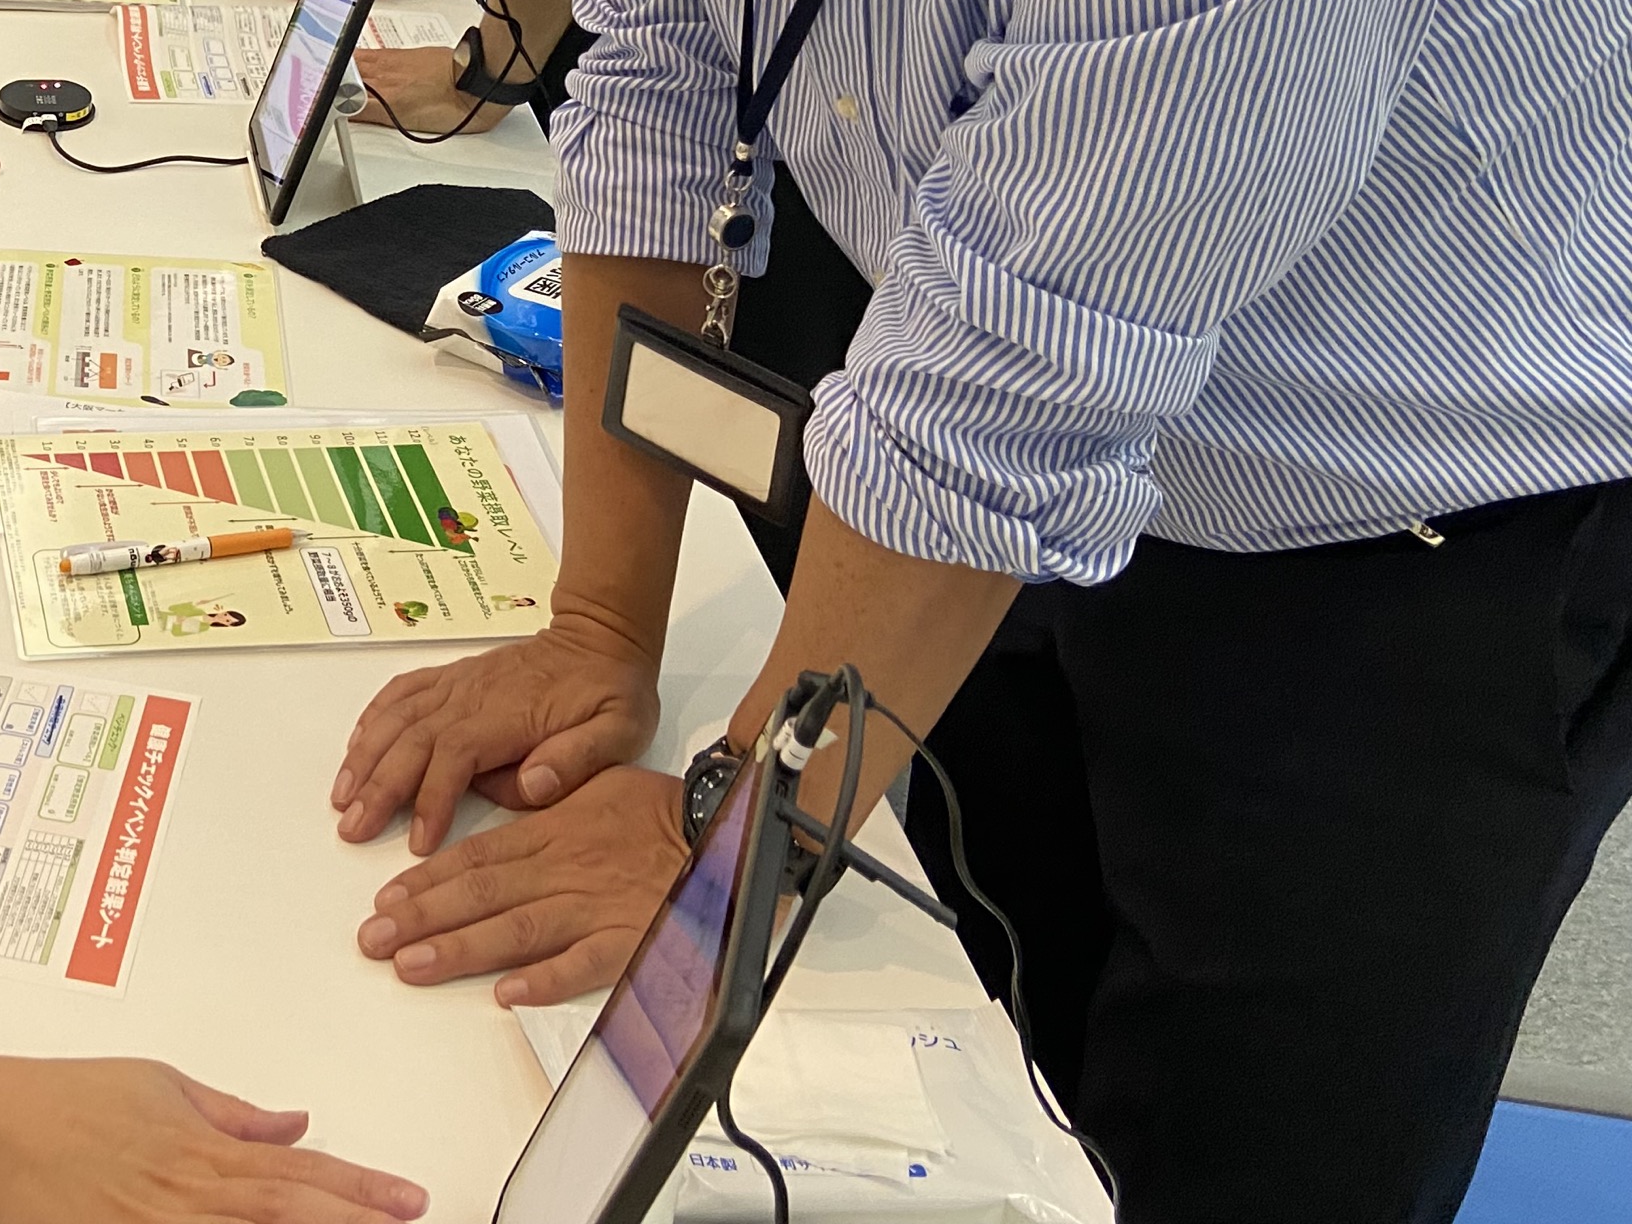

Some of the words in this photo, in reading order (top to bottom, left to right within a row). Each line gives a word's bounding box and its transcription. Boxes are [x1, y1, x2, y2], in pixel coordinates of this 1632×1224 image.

[447, 434, 529, 563] あなたの野菜摂取レベル
[306, 551, 336, 601] 野菜摂取量に相当
[87, 722, 172, 949] 健康チェックイベント判定結果シート
[689, 1153, 737, 1171] 日本製
